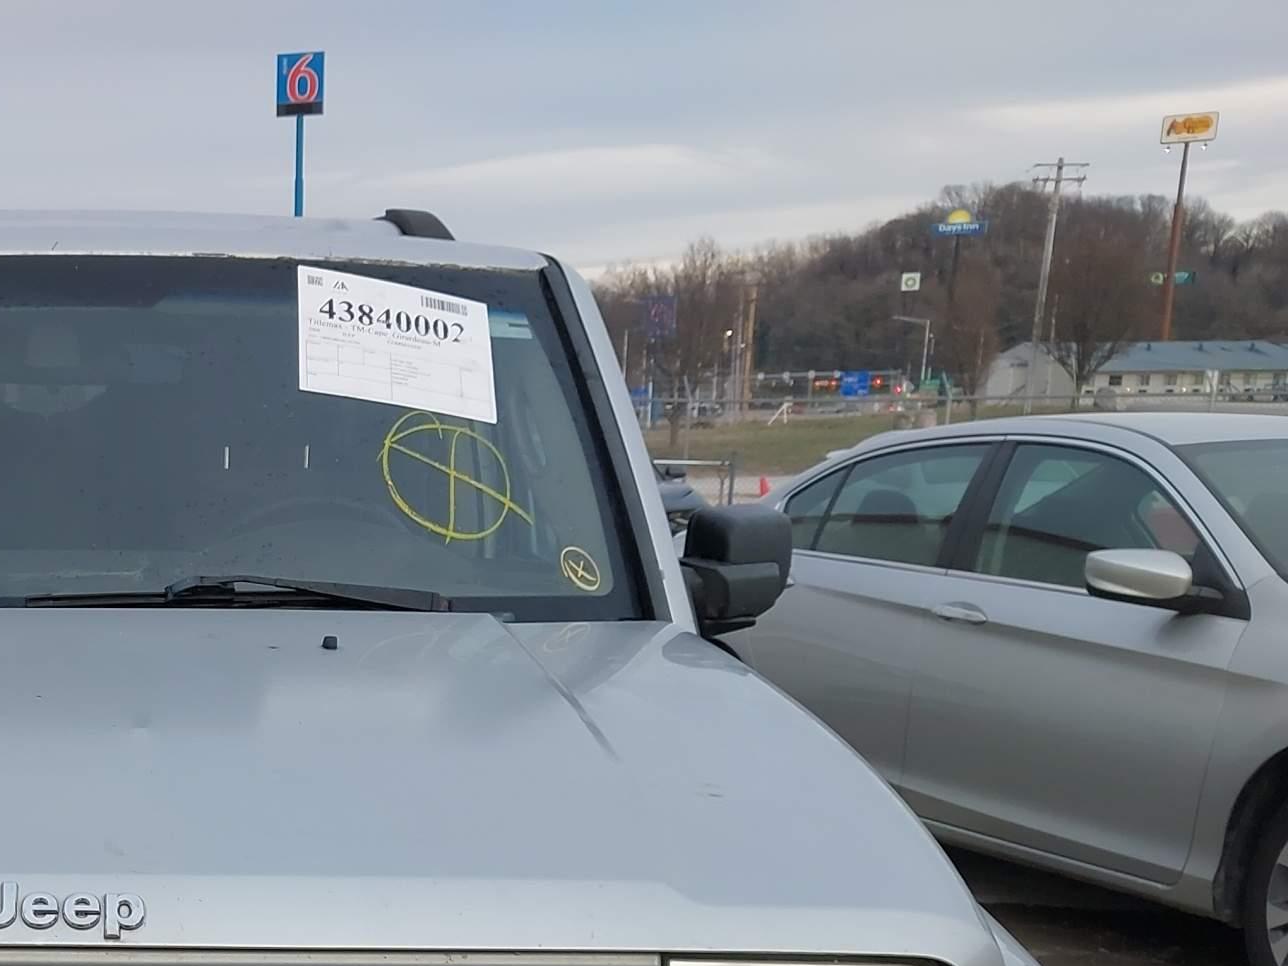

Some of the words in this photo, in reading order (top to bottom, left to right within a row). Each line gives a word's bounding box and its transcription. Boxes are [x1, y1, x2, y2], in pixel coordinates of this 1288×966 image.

[286, 54, 319, 103] 6
[963, 223, 980, 231] Inn
[318, 298, 465, 343] 43840002
